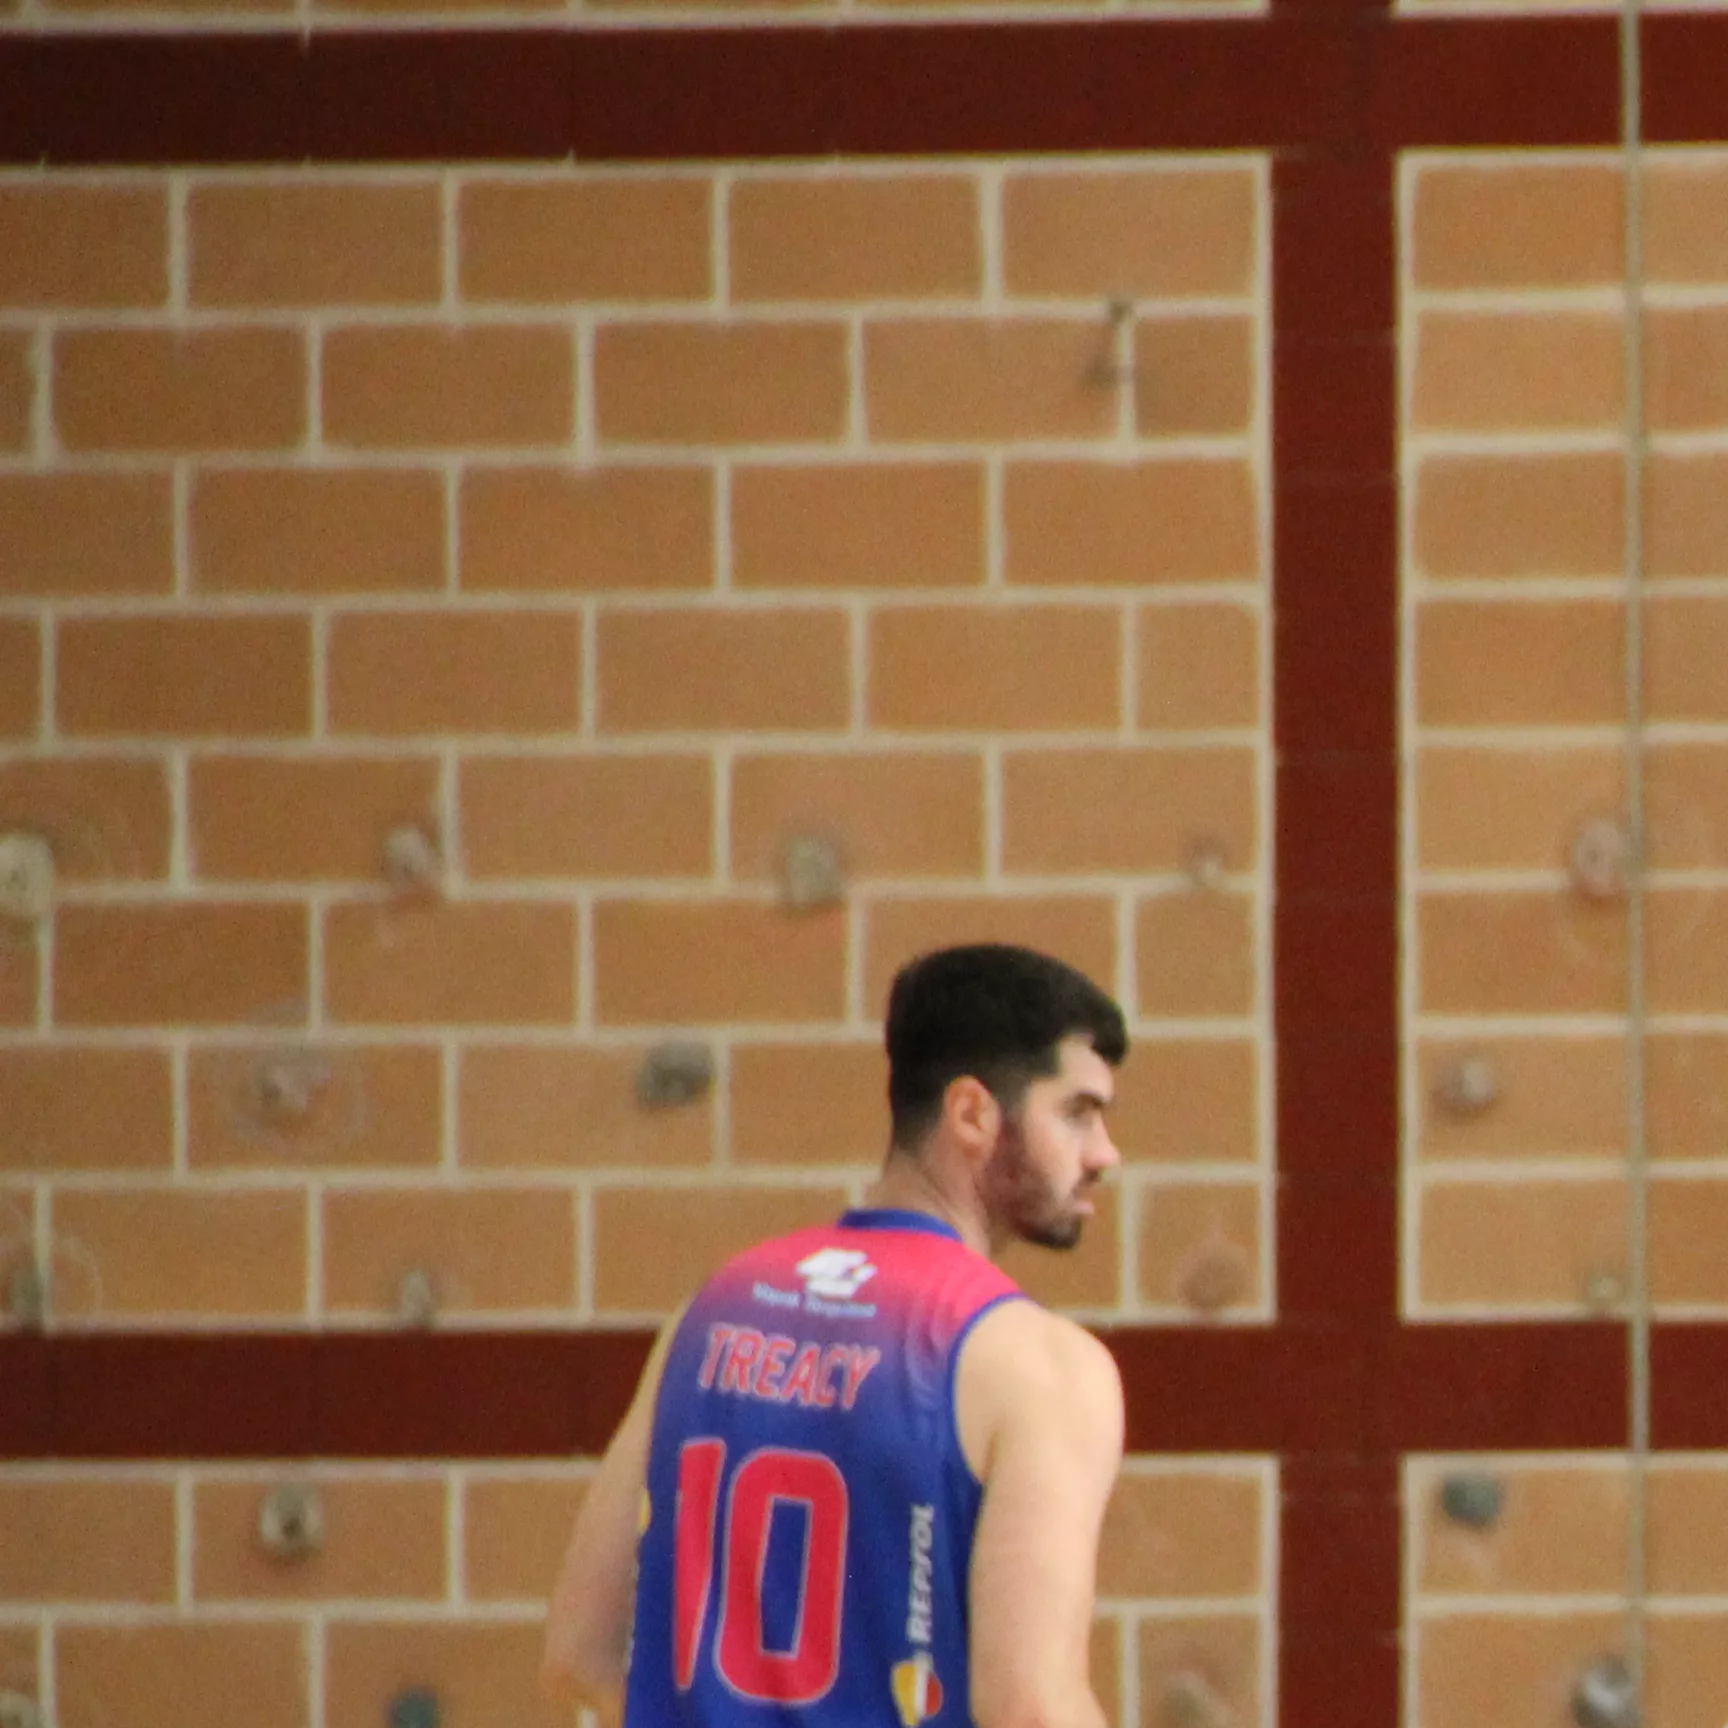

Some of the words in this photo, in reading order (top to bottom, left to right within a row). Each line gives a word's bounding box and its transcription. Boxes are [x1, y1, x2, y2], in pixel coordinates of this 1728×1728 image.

[698, 1321, 882, 1411] TREACY
[673, 1435, 849, 1706] 10
[906, 1504, 935, 1644] REPSOL
